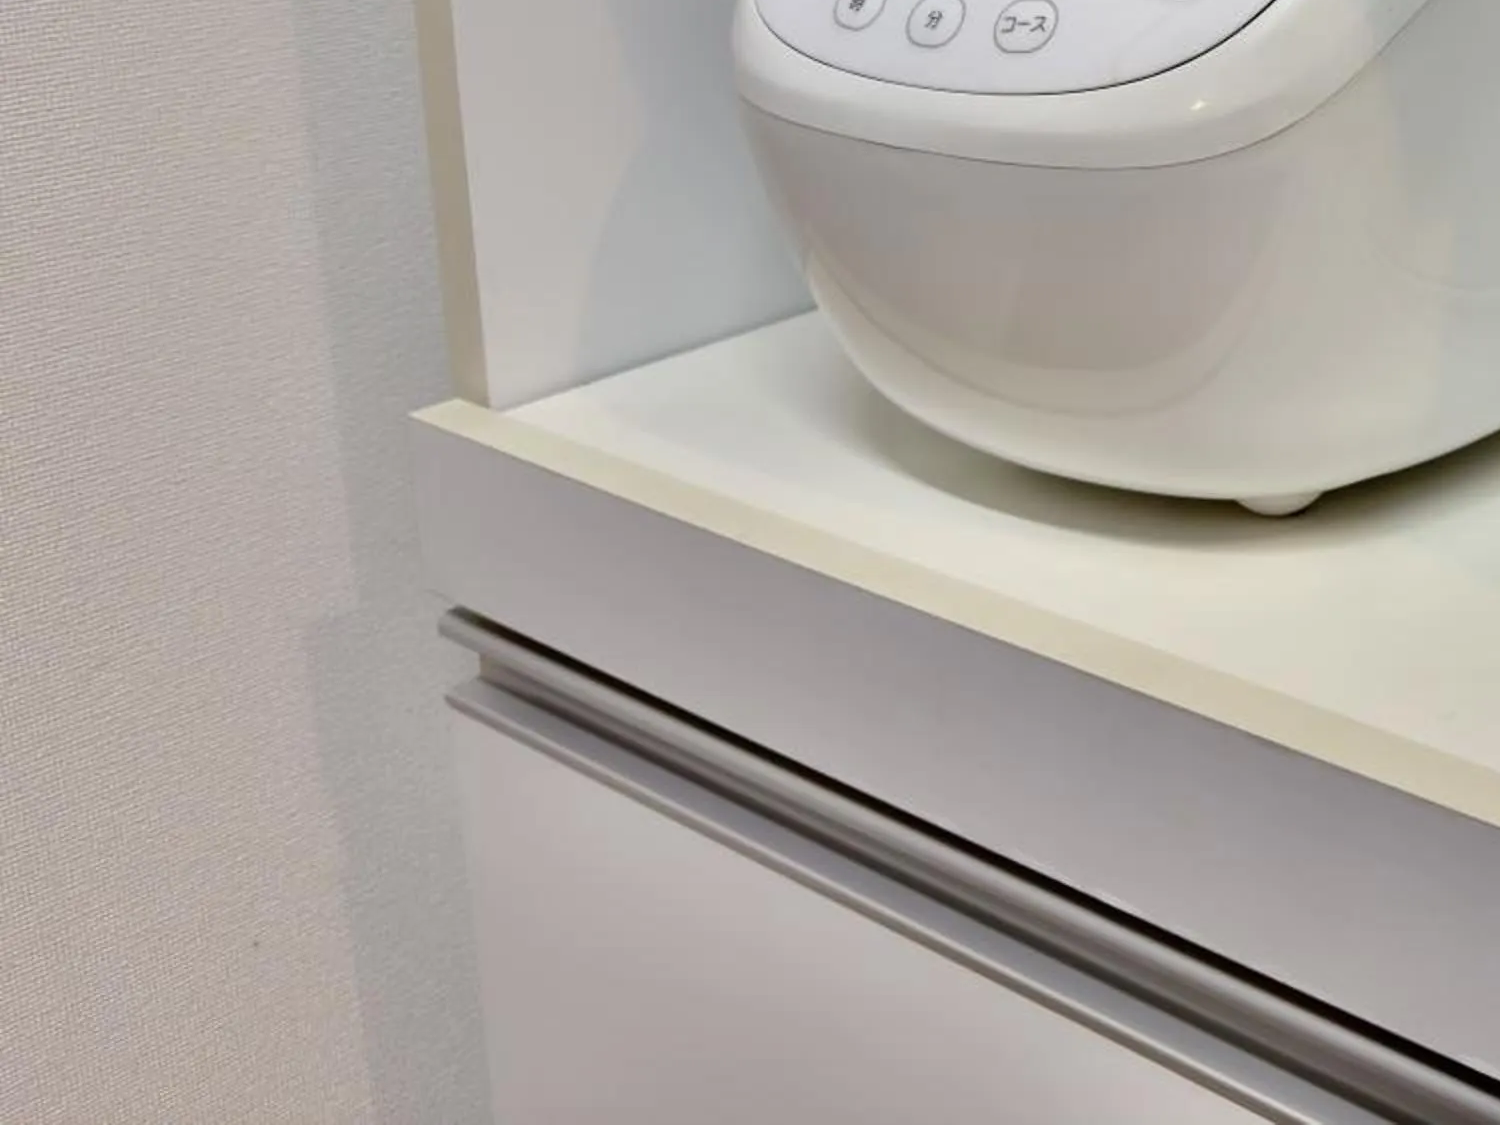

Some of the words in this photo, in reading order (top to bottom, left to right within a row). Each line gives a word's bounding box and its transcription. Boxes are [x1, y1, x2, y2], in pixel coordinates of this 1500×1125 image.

[924, 10, 944, 30] 分
[1000, 15, 1048, 34] コース
